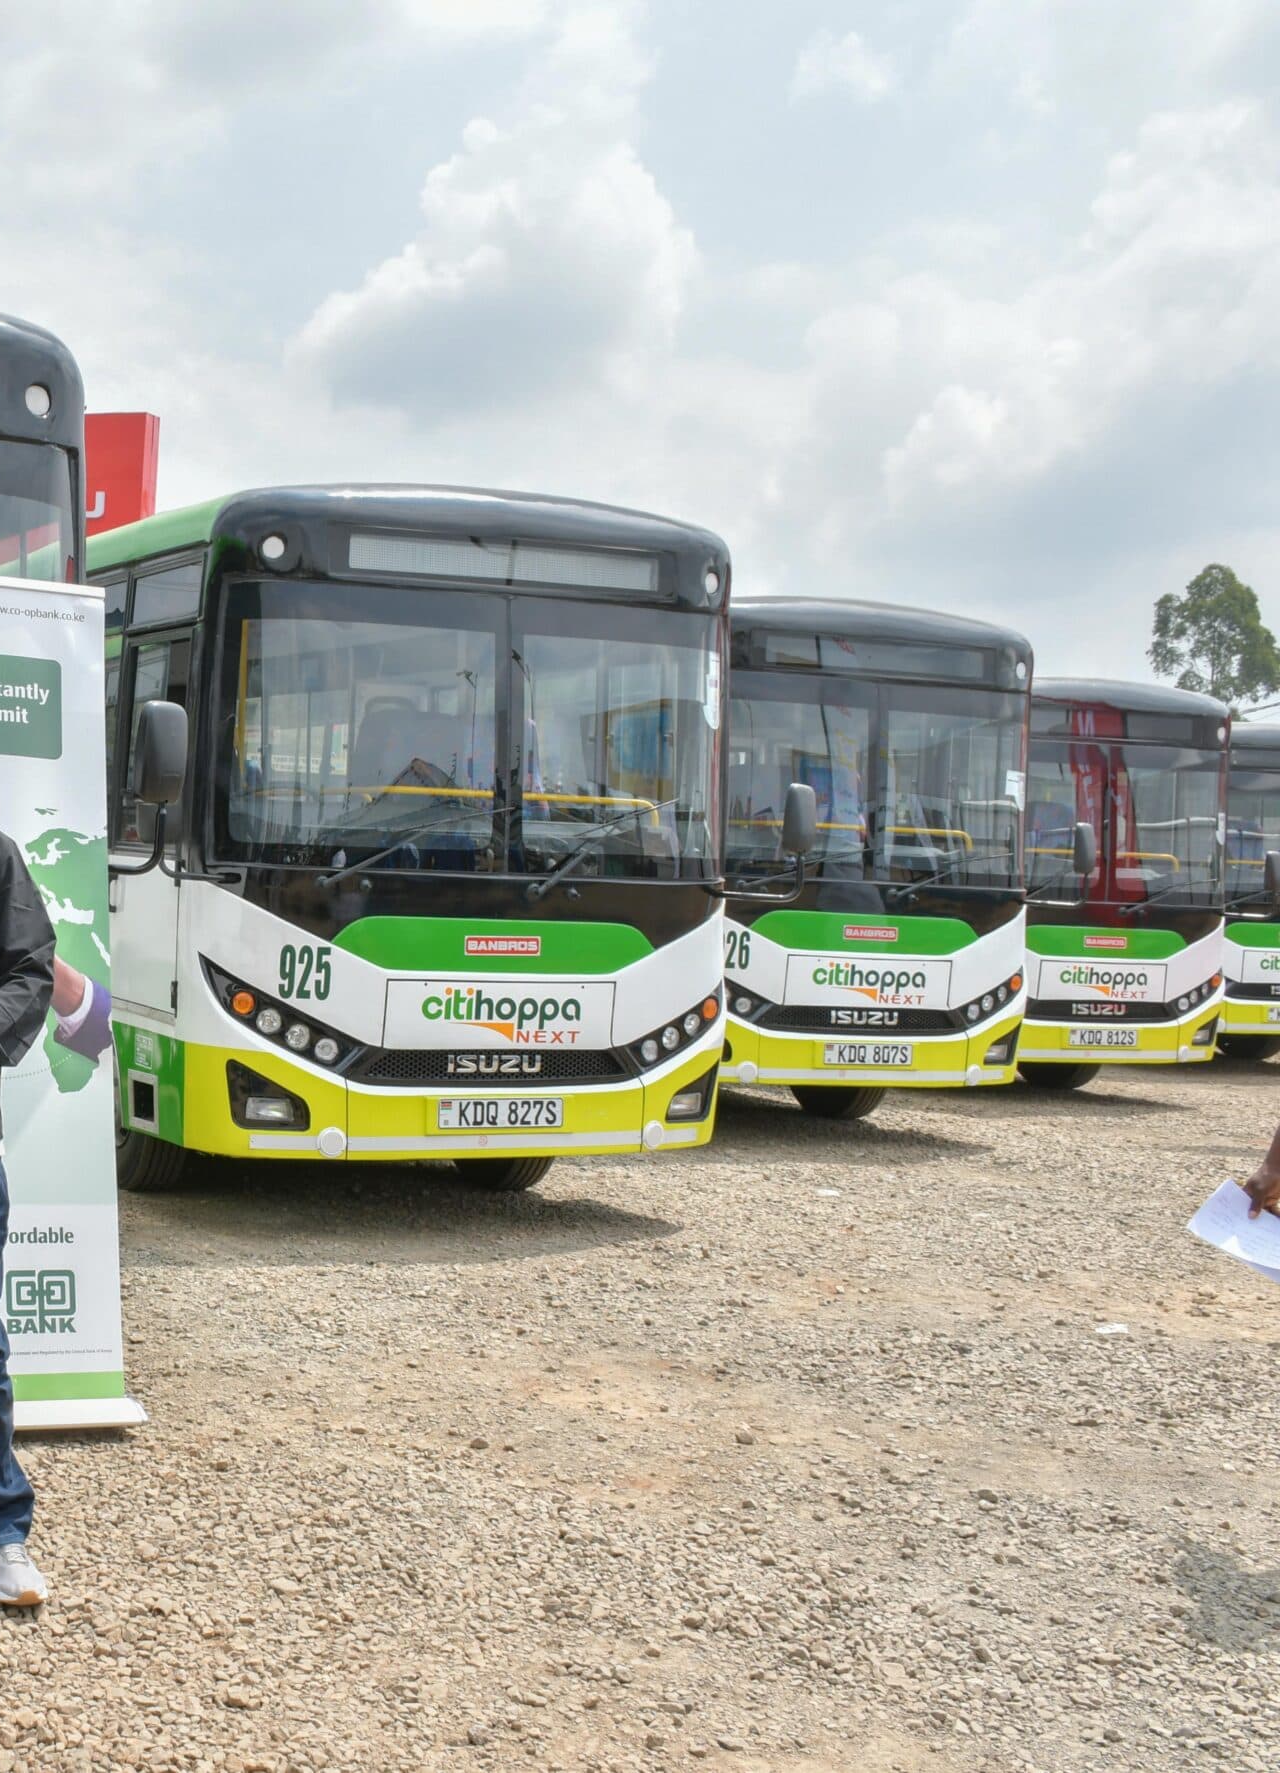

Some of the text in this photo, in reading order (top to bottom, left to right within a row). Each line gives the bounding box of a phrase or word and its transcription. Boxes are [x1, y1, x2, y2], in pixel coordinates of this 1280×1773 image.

[467, 940, 538, 952] BANBROS
[723, 930, 751, 970] 26
[278, 944, 332, 1001] 925
[811, 961, 926, 994] citihoppa
[1060, 965, 1148, 990] citihoppa
[878, 994, 925, 1005] NEXT
[1111, 990, 1147, 999] NEXT
[421, 987, 581, 1030] citihoppa
[830, 1009, 898, 1025] ISUZU
[1071, 1003, 1127, 1015] ISUZU
[516, 1030, 580, 1044] NEXT
[1080, 1031, 1135, 1045] KDQ 812S
[447, 1054, 542, 1073] ISUZU
[838, 1045, 867, 1064] KDQ
[458, 1100, 557, 1126] KDQ 827S
[6, 1317, 77, 1335] BANK
